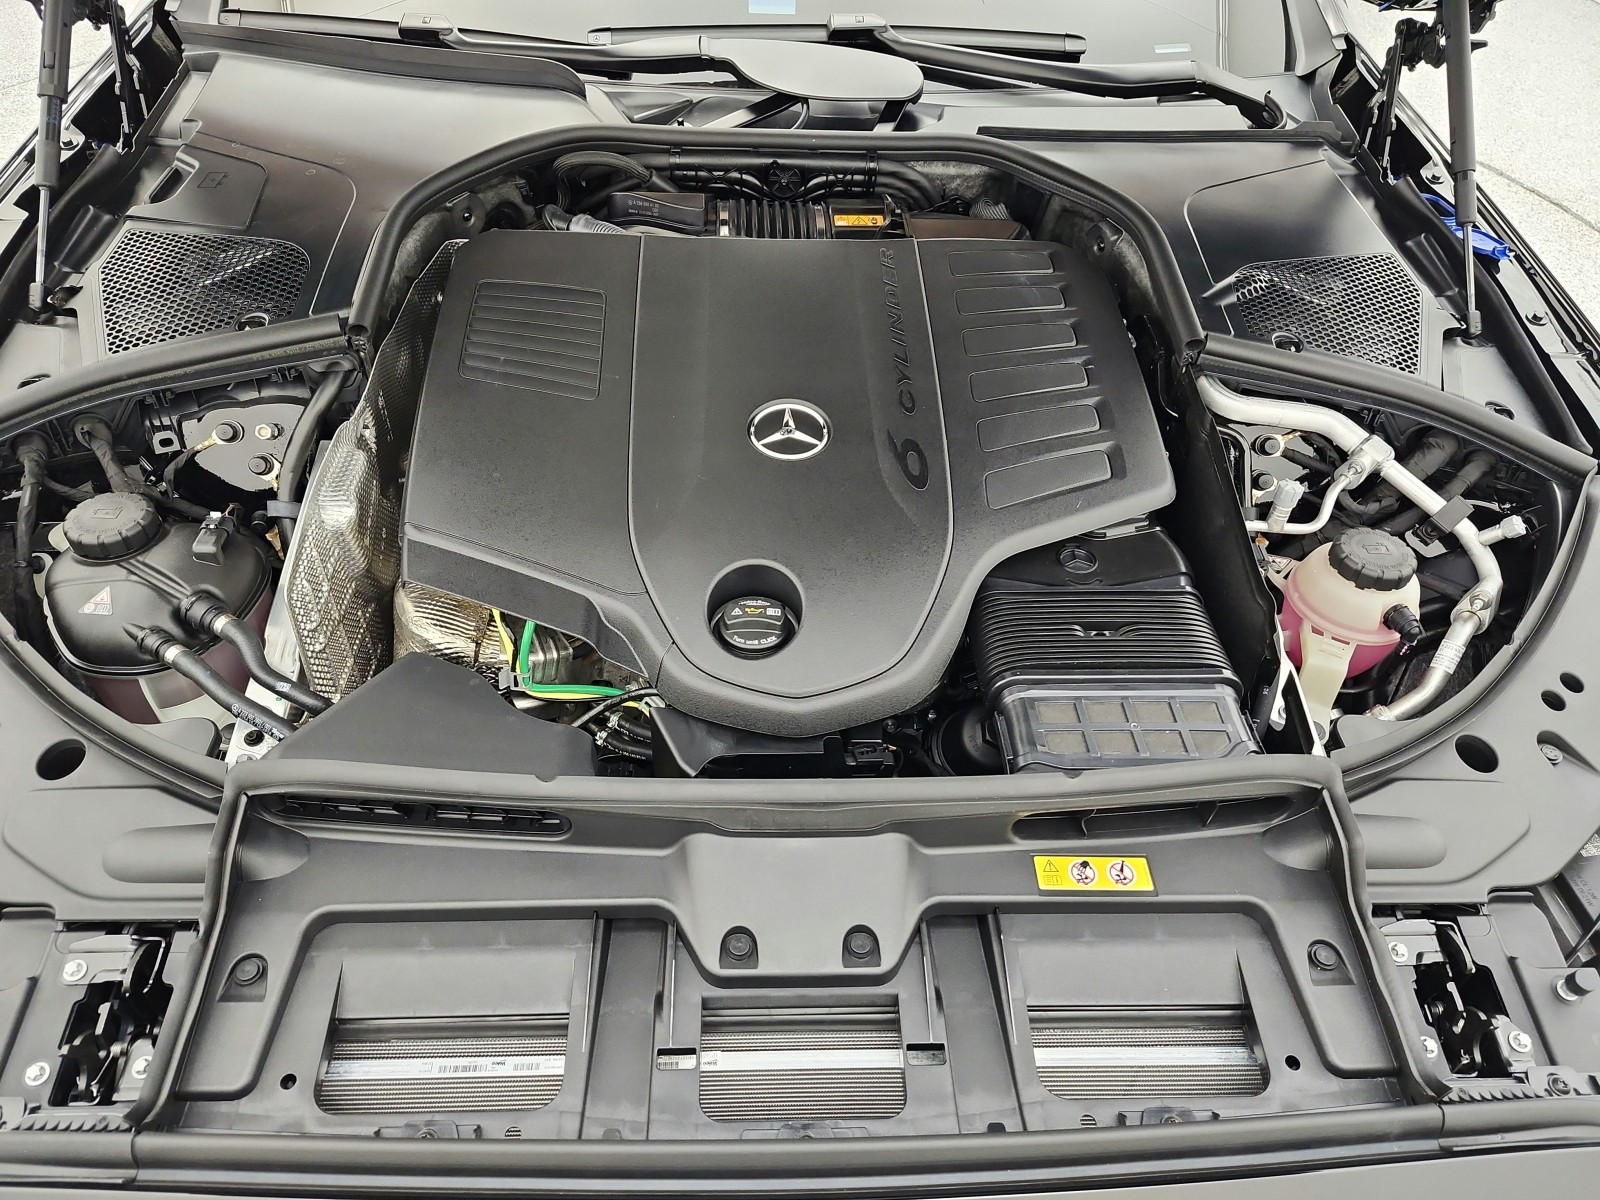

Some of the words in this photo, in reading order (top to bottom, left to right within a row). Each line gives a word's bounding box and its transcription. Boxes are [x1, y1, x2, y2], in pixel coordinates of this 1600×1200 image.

[879, 247, 917, 416] CYLINDER
[887, 428, 930, 491] 6
[733, 635, 745, 643] Turn
[760, 635, 777, 644] CLICK
